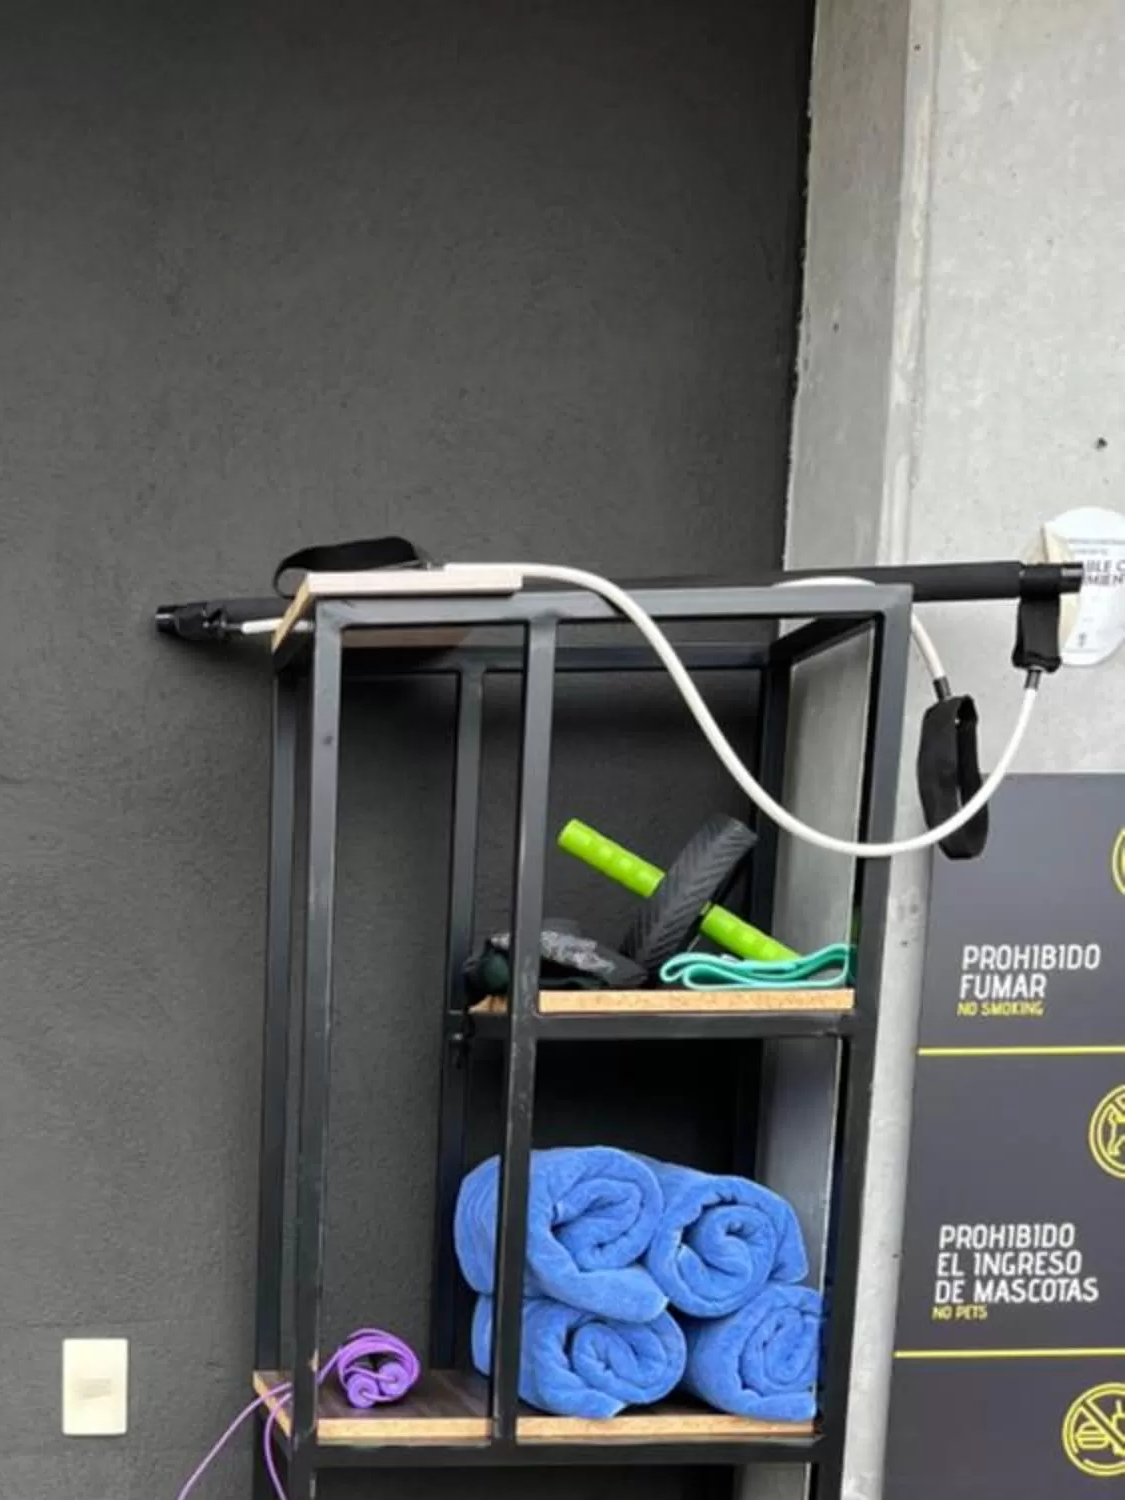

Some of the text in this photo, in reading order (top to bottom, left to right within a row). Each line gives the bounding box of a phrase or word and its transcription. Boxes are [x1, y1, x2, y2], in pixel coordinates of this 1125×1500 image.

[962, 944, 1101, 971] PROHIBIDO
[960, 973, 1047, 999] FUMAR
[957, 1000, 1044, 1017] NO SMOKING
[939, 1222, 1076, 1250] PROHIBIDO
[937, 1250, 1083, 1276] EL INGRESO
[935, 1277, 1100, 1304] DE MASCOTAS
[932, 1305, 988, 1320] NO PETS
